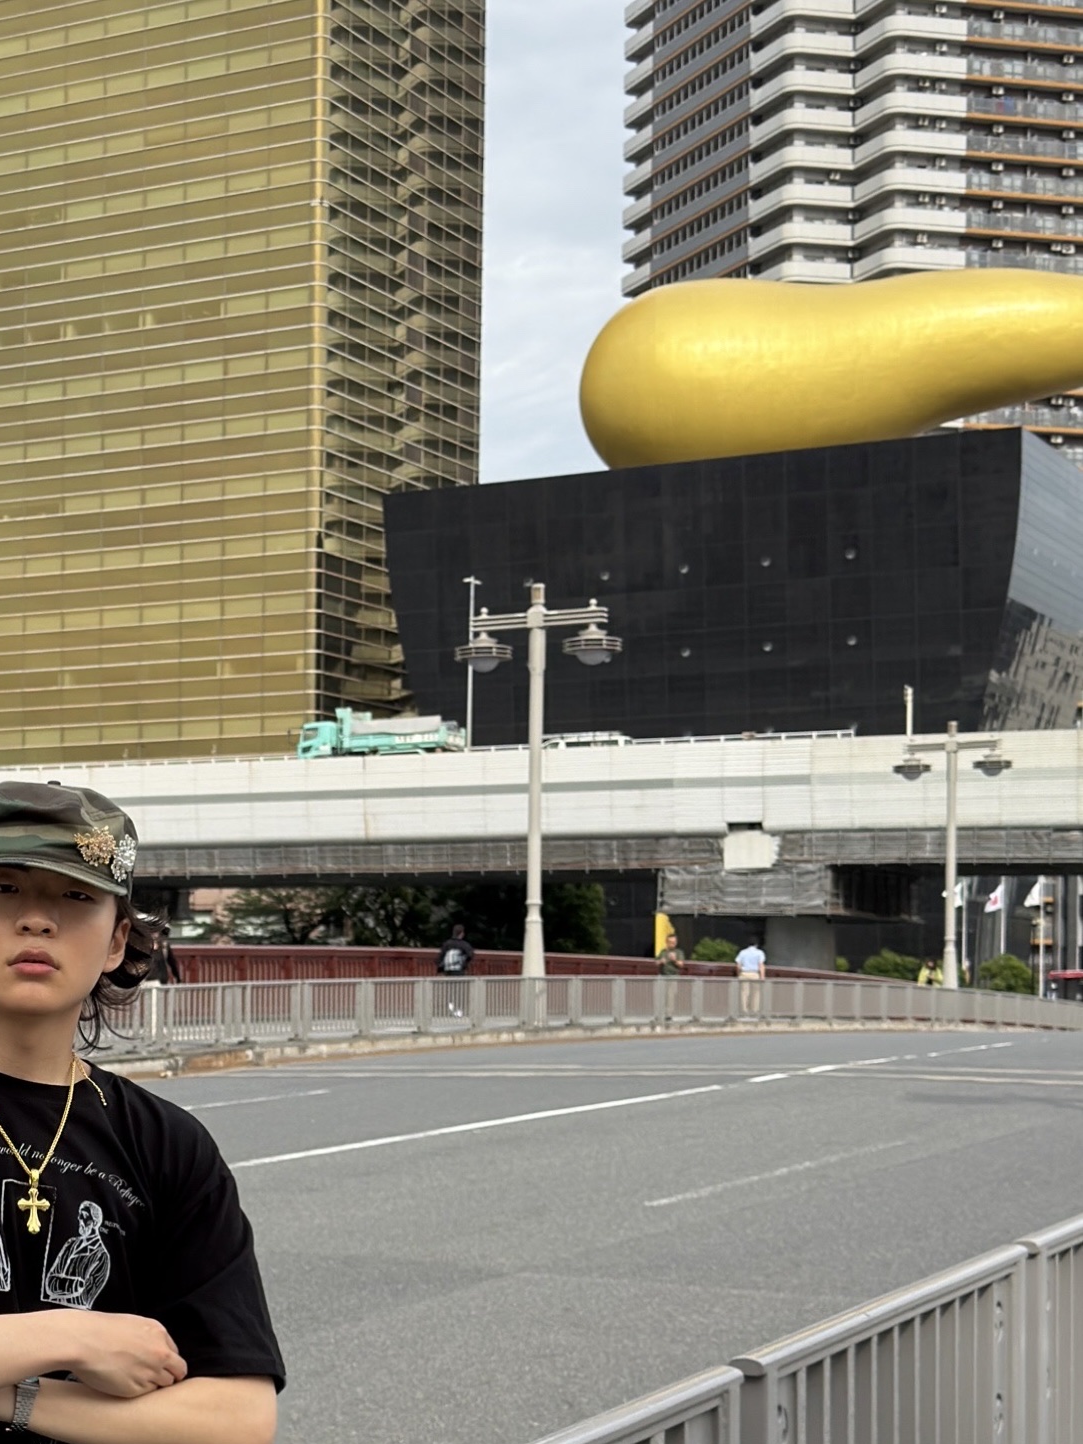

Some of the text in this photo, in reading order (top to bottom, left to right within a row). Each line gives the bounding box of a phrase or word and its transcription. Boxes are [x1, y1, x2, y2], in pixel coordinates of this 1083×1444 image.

[31, 1150, 45, 1159] no
[49, 1152, 82, 1174] onger
[84, 1162, 98, 1176] be
[98, 1171, 106, 1180] a
